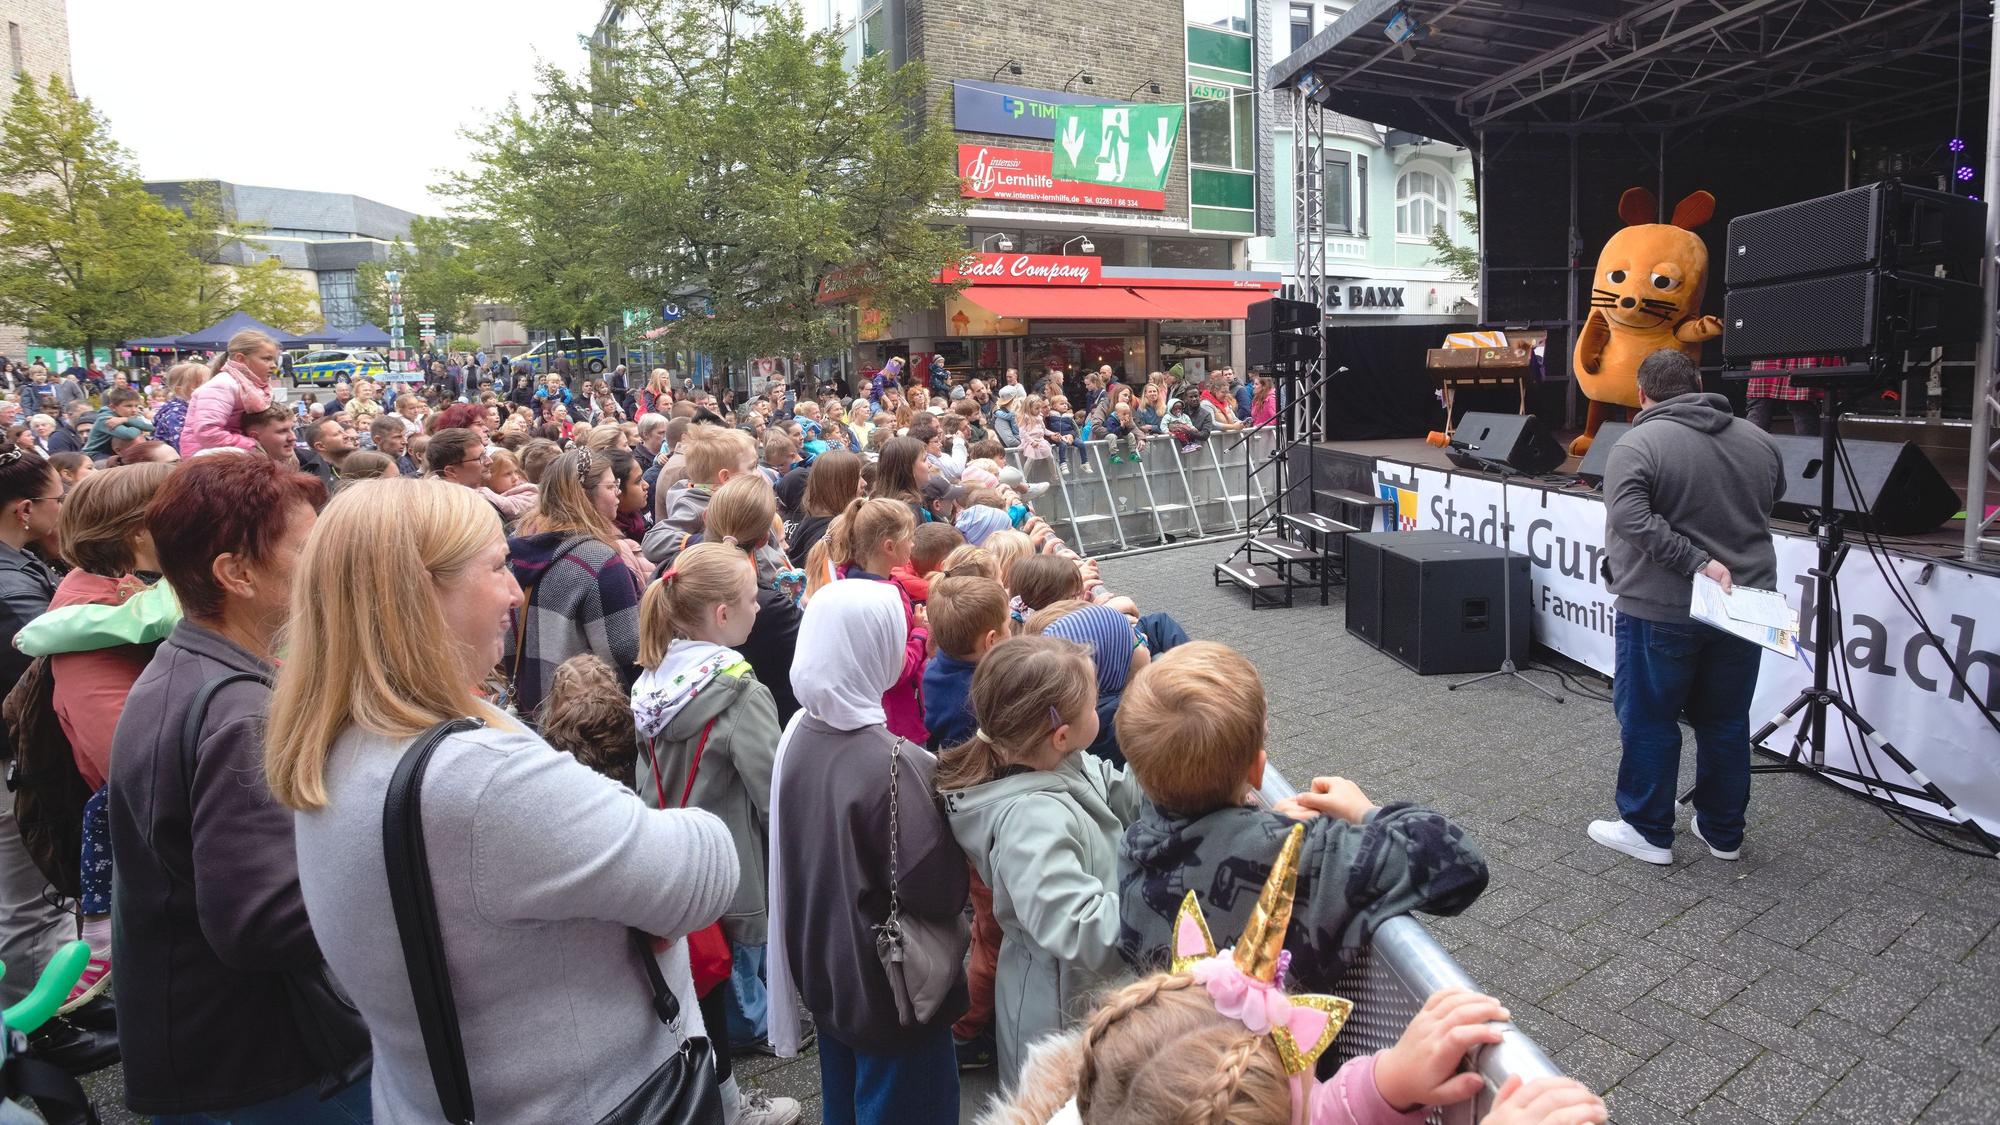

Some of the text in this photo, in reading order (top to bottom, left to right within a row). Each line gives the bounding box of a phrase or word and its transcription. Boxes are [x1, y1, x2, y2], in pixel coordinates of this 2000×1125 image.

[990, 157, 1021, 168] intensiv
[997, 171, 1053, 188] Lernhilfe
[994, 191, 1080, 203] www.intensiv-lernhilfe.de
[1010, 255, 1089, 283] Company
[1348, 286, 1404, 307] BAXX
